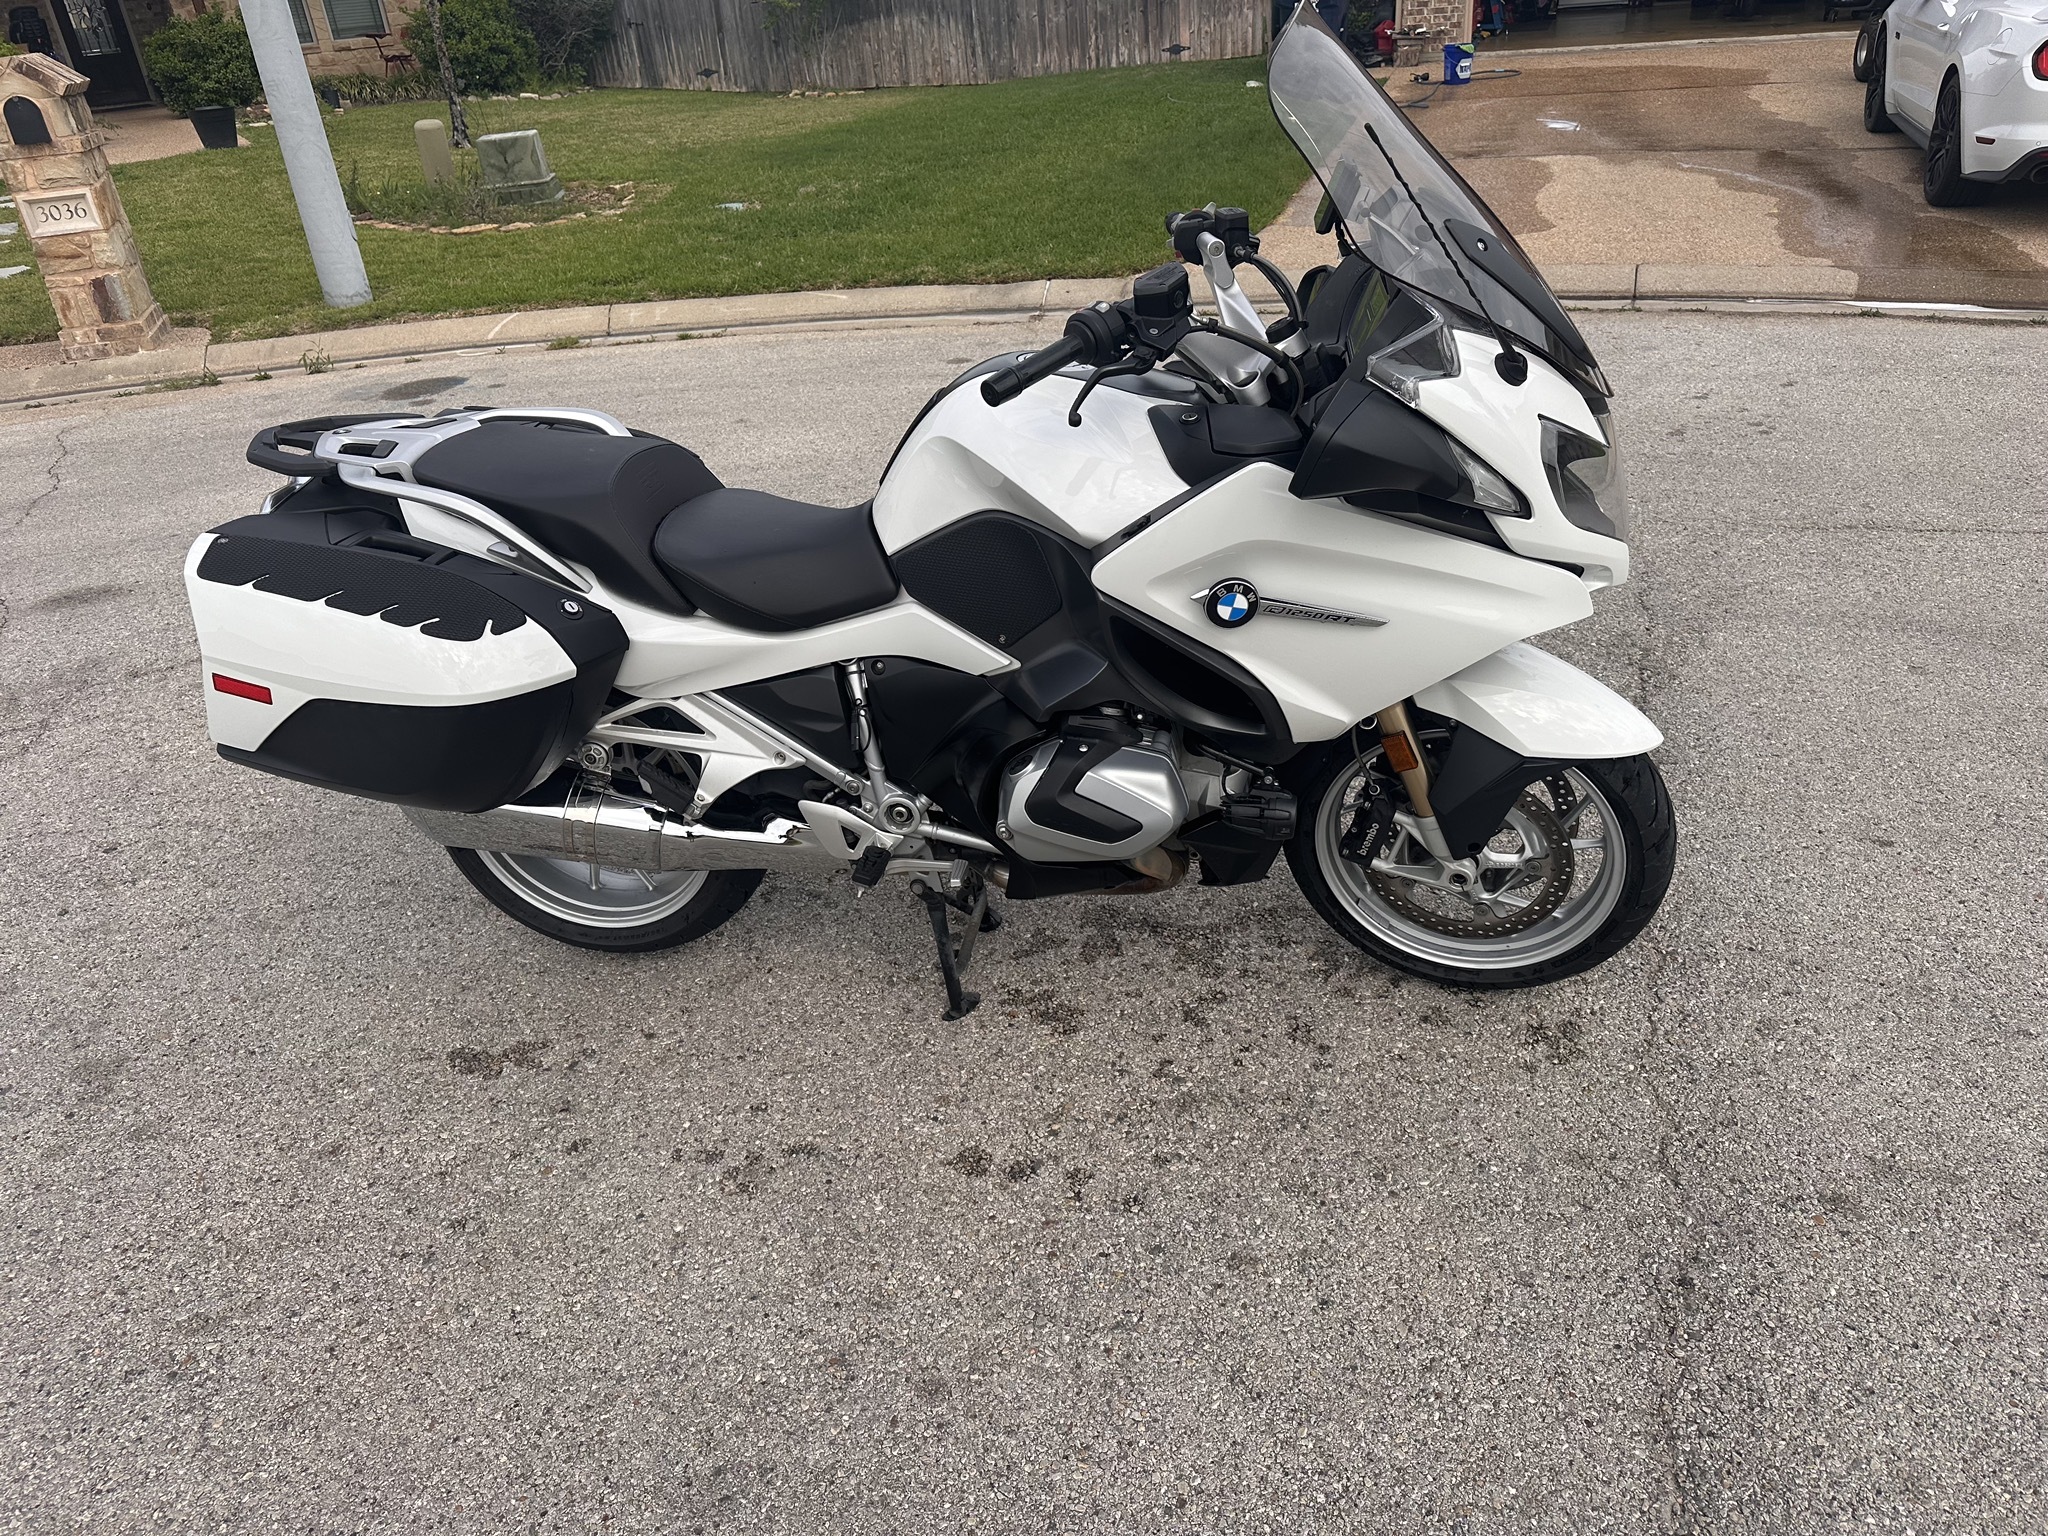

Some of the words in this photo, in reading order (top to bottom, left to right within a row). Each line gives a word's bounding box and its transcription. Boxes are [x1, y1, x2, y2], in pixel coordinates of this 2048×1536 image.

[36, 202, 87, 223] 3036
[1216, 584, 1258, 603] BMW
[1357, 823, 1380, 857] brembo
